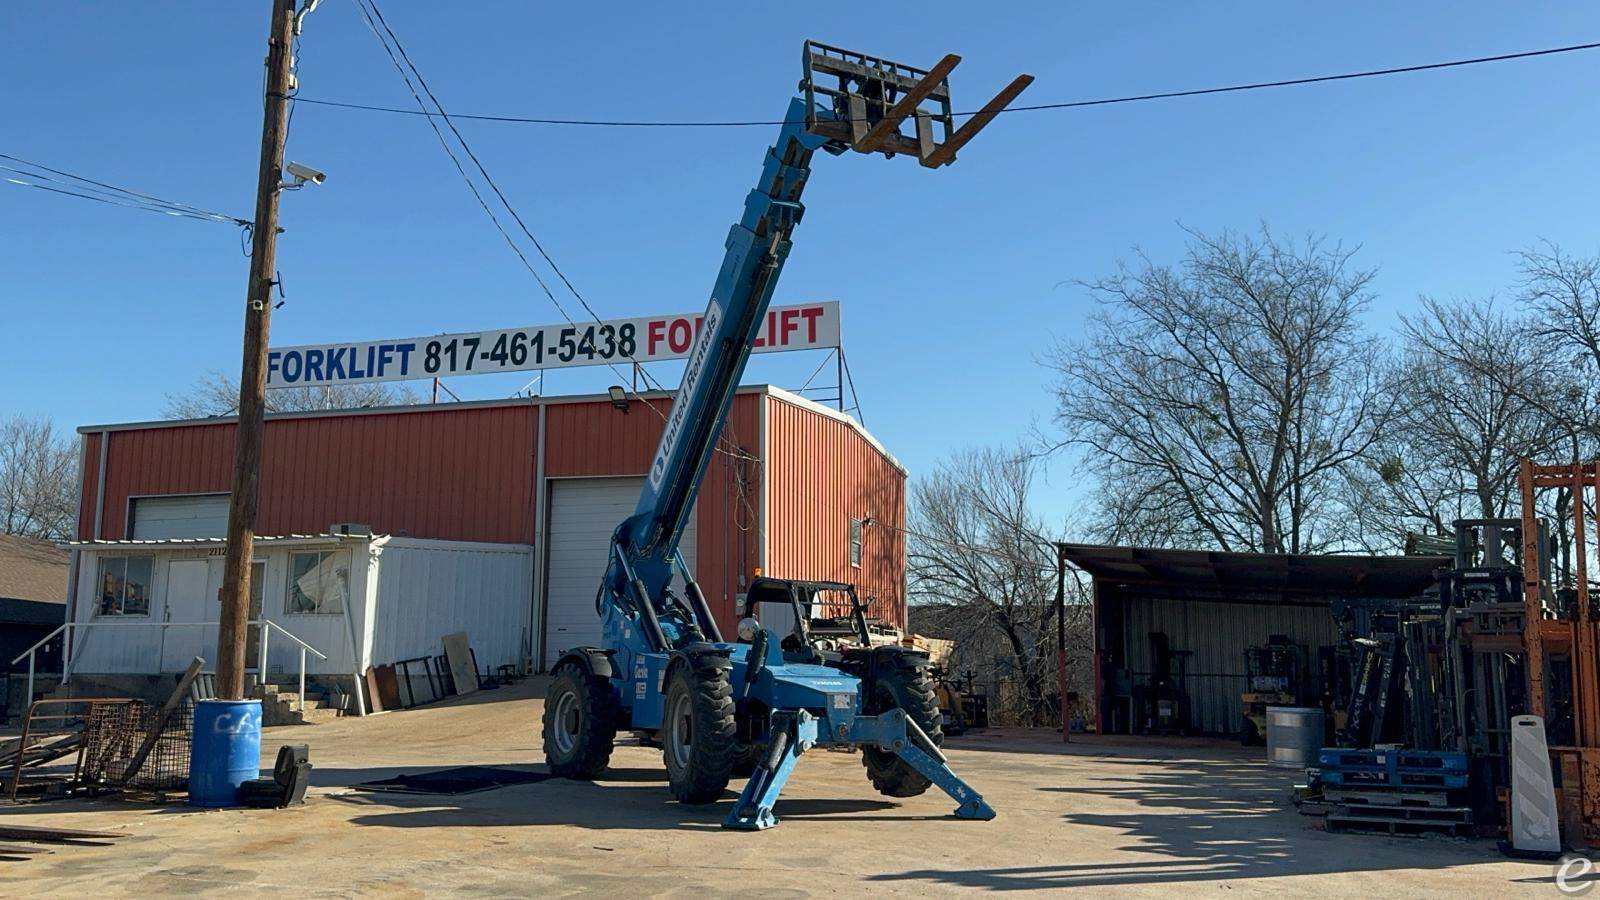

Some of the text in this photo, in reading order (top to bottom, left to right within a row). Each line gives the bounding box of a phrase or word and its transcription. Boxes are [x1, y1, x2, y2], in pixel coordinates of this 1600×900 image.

[267, 307, 824, 383] FORKLIFT 817-461-5438 FOIFT
[662, 314, 716, 456] United Rentals
[209, 547, 226, 556] 2112
